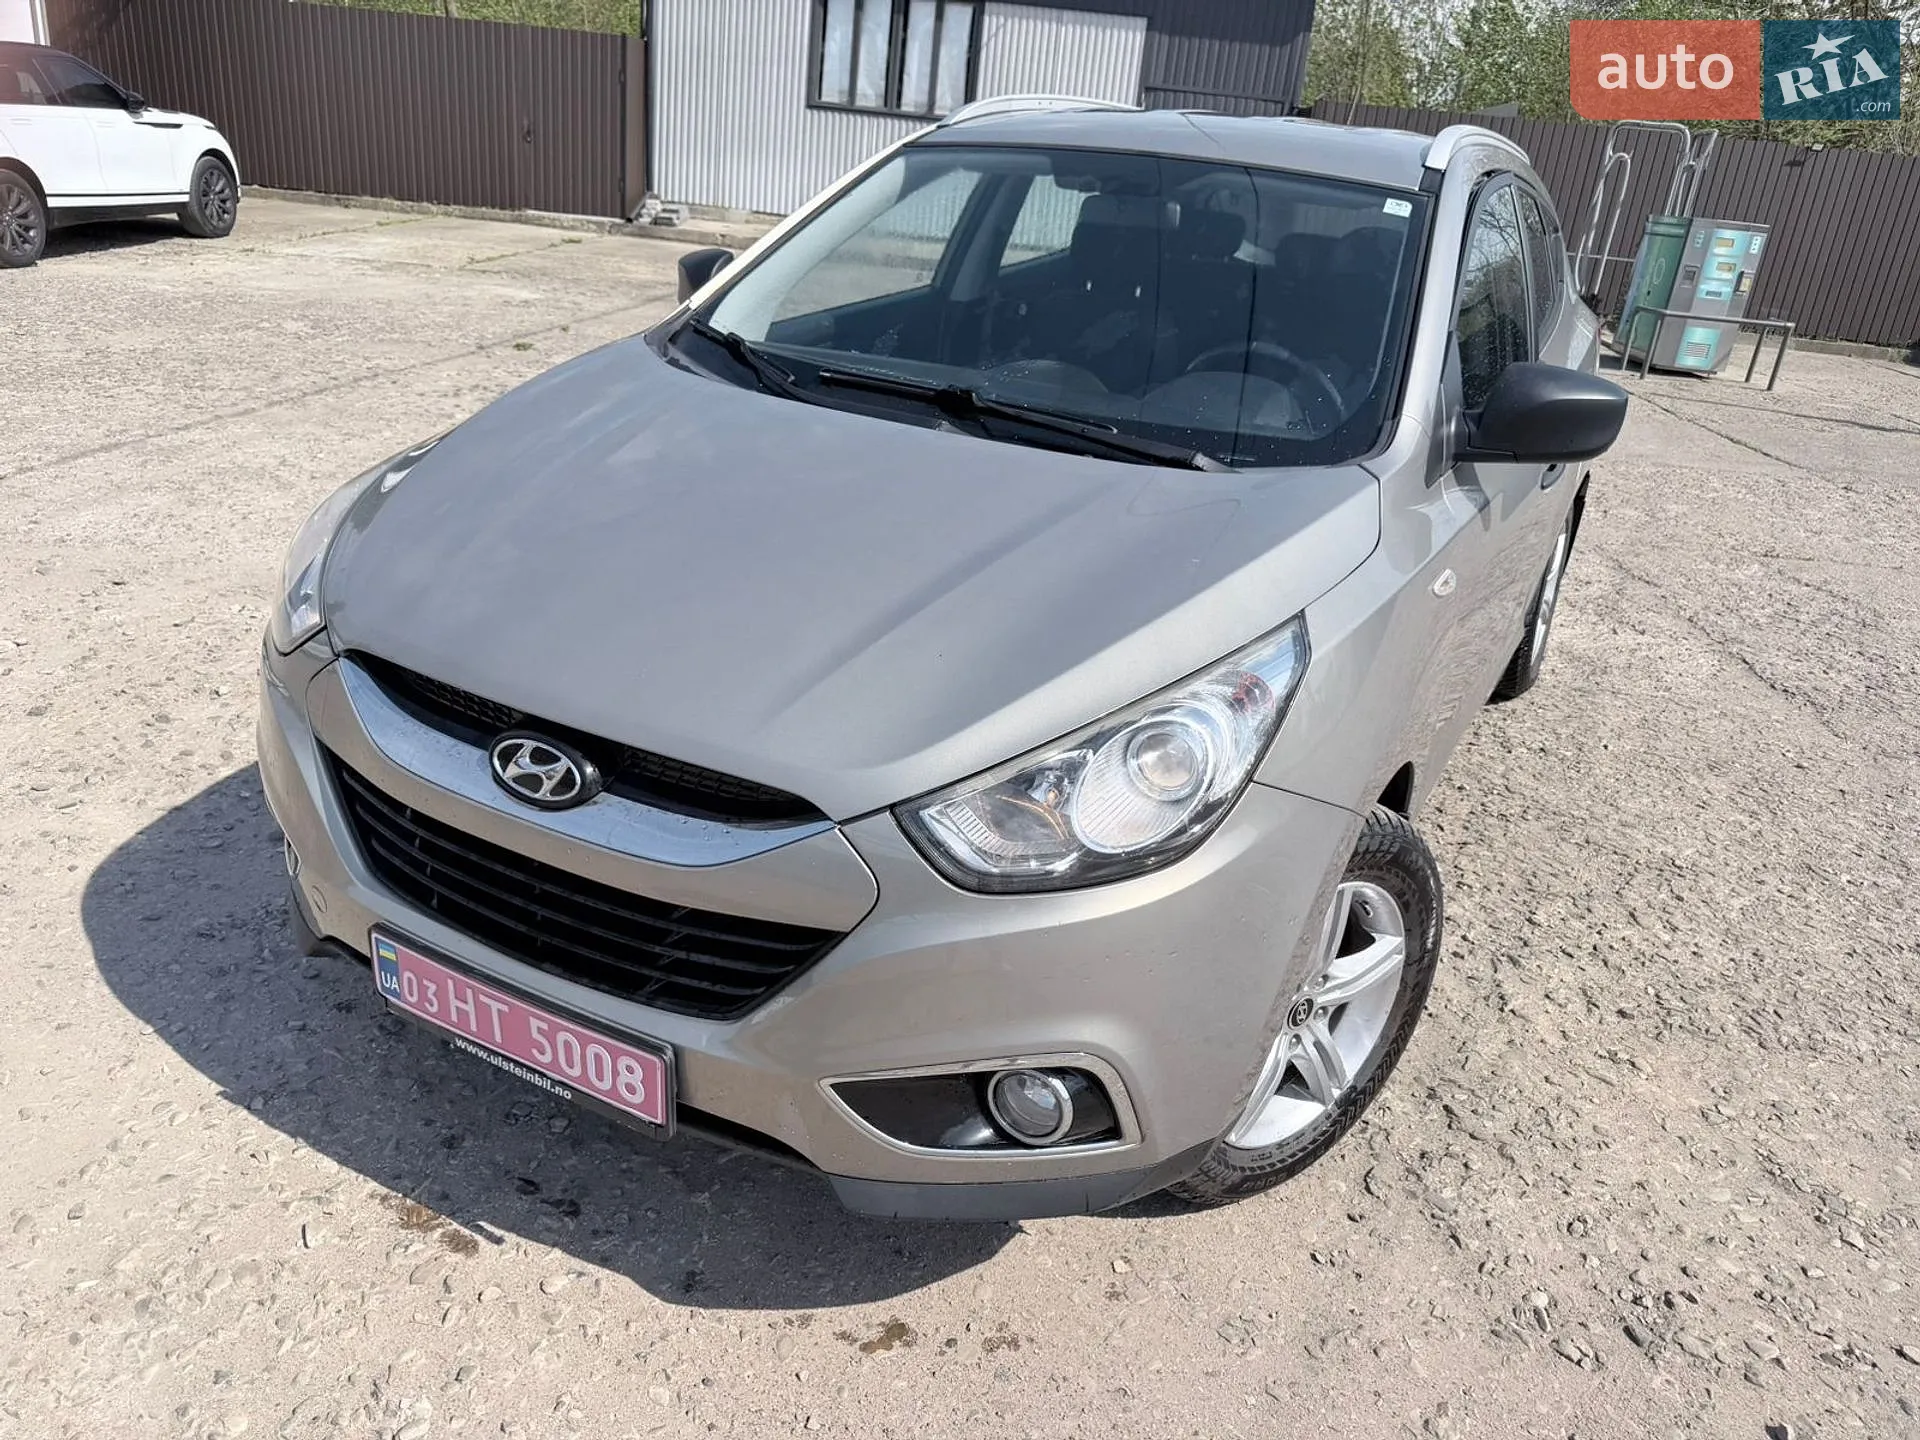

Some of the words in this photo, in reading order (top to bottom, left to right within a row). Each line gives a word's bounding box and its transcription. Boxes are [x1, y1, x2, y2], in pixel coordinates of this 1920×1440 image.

[381, 970, 400, 993] UA
[402, 970, 440, 1014] 03
[447, 978, 509, 1045] HT
[528, 1017, 646, 1105] 5008
